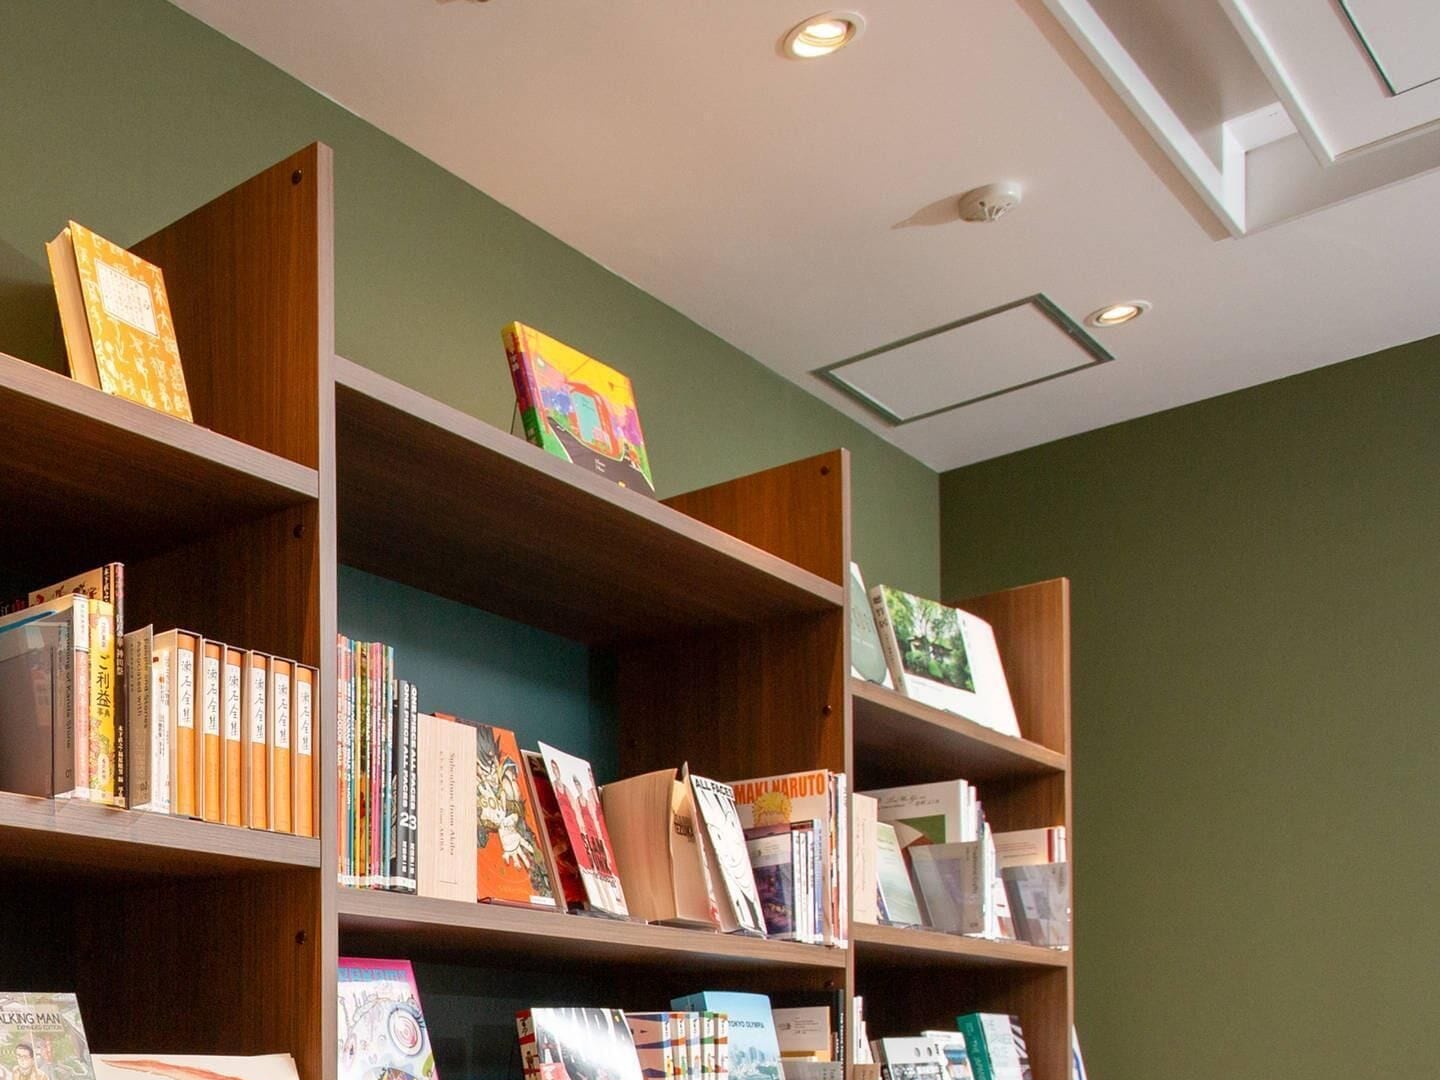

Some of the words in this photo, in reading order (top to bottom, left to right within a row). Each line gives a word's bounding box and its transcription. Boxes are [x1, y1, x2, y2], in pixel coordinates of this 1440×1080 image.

[694, 777, 711, 791] ALL
[771, 774, 825, 799] NARUTO
[36, 1013, 61, 1024] MAN
